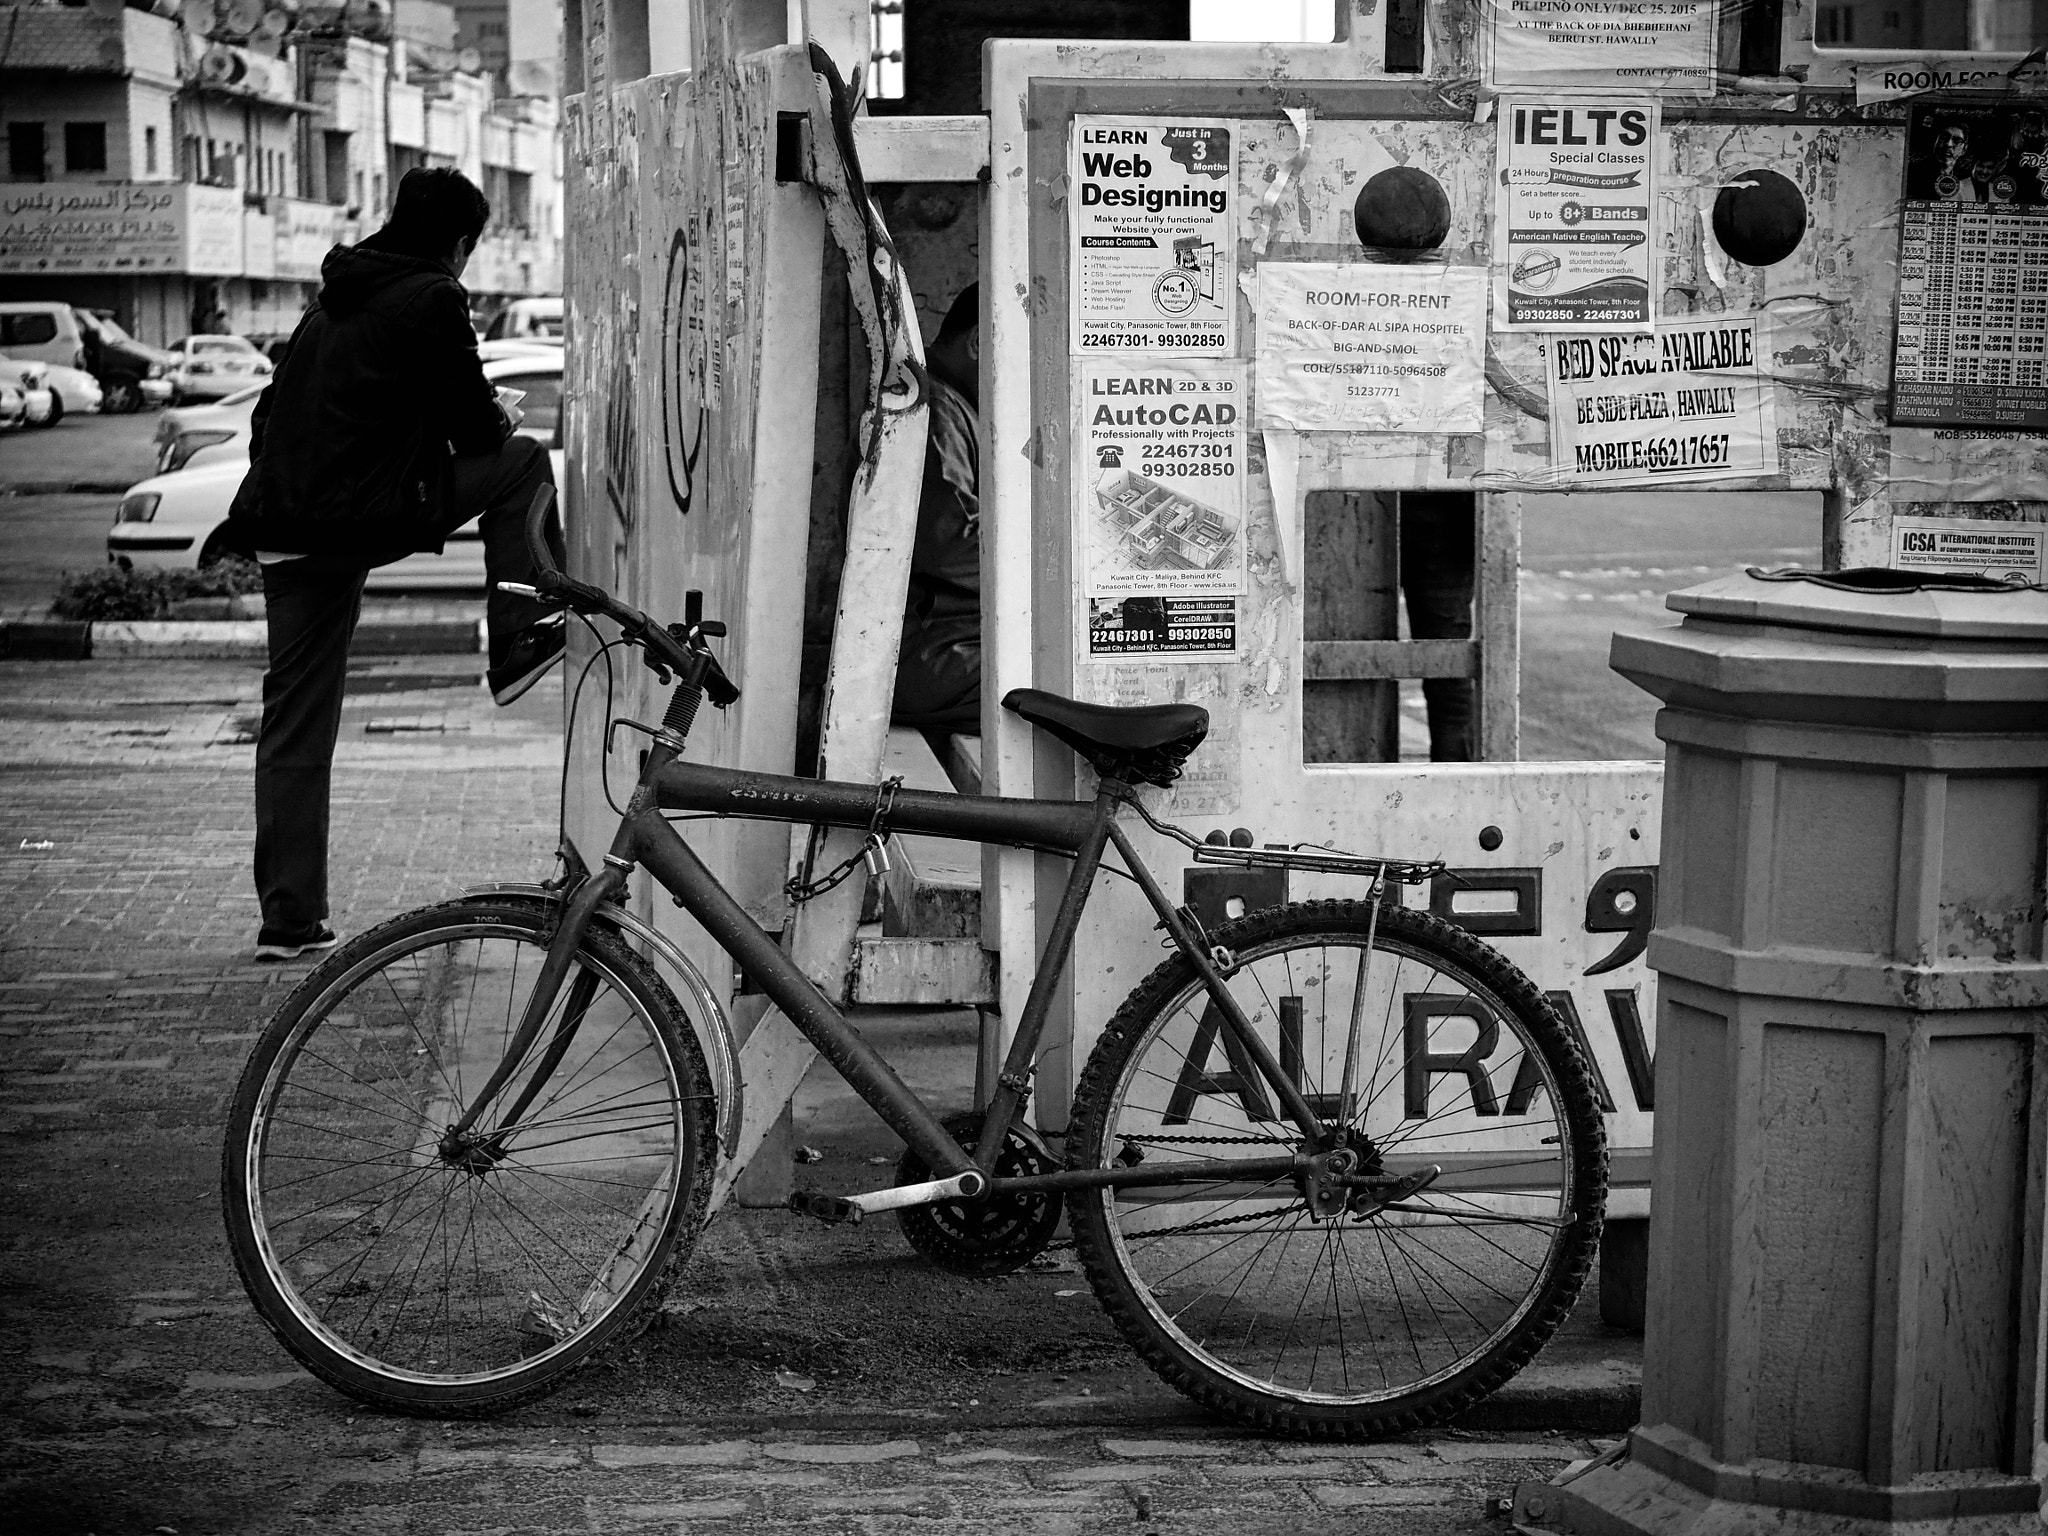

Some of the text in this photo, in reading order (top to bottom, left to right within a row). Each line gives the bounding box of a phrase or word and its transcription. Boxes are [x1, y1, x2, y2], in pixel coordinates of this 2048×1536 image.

[1574, 2, 1616, 14] ONLY/
[1620, 3, 1646, 14] DEC
[1671, 5, 1698, 15] 2015
[1516, 21, 1531, 29] AT
[1533, 21, 1552, 30] THE
[1556, 22, 1583, 30] BACK
[1603, 23, 1620, 31] DIA
[1548, 35, 1658, 45] BEIRUT ST. HAWALLY
[1616, 68, 1708, 78] CONTACT 67740859
[1884, 71, 1952, 90] ROOM
[1515, 109, 1647, 146] IELTS
[1083, 129, 1211, 145] LEARN Just in
[1083, 141, 1207, 178] Web 3
[1550, 152, 1645, 164] Special Classes
[1193, 163, 1228, 171] Months
[1512, 169, 1629, 187] 24 Hours preparation course
[1082, 183, 1227, 213] Designing
[1539, 190, 1559, 198] better
[1529, 207, 1640, 220] Up to 8+ Bands
[1094, 215, 1214, 226] Make your fully functional
[1113, 225, 1150, 234] Website
[1152, 227, 1173, 236] your
[1086, 237, 1151, 247] Course Contents
[1512, 233, 1644, 243] American Native English Teacher
[1091, 254, 1121, 262] Photoshop
[1593, 259, 1628, 267] individually
[1178, 281, 1185, 292] 1
[1306, 290, 1451, 309] ROOM-FOR-RENT
[1538, 299, 1553, 307] City,
[1590, 299, 1611, 307] Tower,
[1516, 310, 1641, 321] 99302850 22467301
[1084, 321, 1201, 331] Kuwait City, Panasonic Tower, 8th
[1289, 319, 1464, 335] BACK-OF-DAR AL SIPA HOSPITEL
[1082, 334, 1225, 347] 22467301- 99302850
[1333, 342, 1418, 355] BIG-AND-SMOL
[1557, 338, 1594, 381] BED
[1661, 327, 1753, 373] AVAILABLE
[1092, 378, 1234, 396] LEARN 2D & 3D
[1347, 386, 1400, 397] 51237771
[1577, 386, 1737, 424] BE SIDE PLAZA HAWALLY
[1092, 404, 1236, 426] AutoCAD
[1091, 430, 1235, 441] Professionally with Projects
[1141, 444, 1233, 459] 22467301
[1575, 434, 1730, 473] MOBILE:66217657
[1141, 463, 1235, 477] 99302850
[1903, 532, 2035, 552] ICSA INTERNATIONAL INSTITUTE
[1987, 558, 2012, 566] Computer
[1110, 571, 1222, 583] Kuwait City Maliya, Behind KFC
[1096, 583, 1131, 591] Panasonic
[1134, 582, 1155, 591] Tower,
[1193, 581, 1237, 589] www.icsa.us
[1172, 601, 1230, 611] Adobe Illustrator
[1173, 614, 1212, 623] CorelDRAW
[1092, 628, 1232, 643] 22467301 99302850
[1111, 644, 1123, 653] City
[1126, 643, 1146, 651] Behind
[1160, 642, 1187, 650] Panasonic
[1207, 641, 1217, 649] 8th
[1218, 640, 1232, 648] Floor
[1160, 995, 1357, 1125] AL
